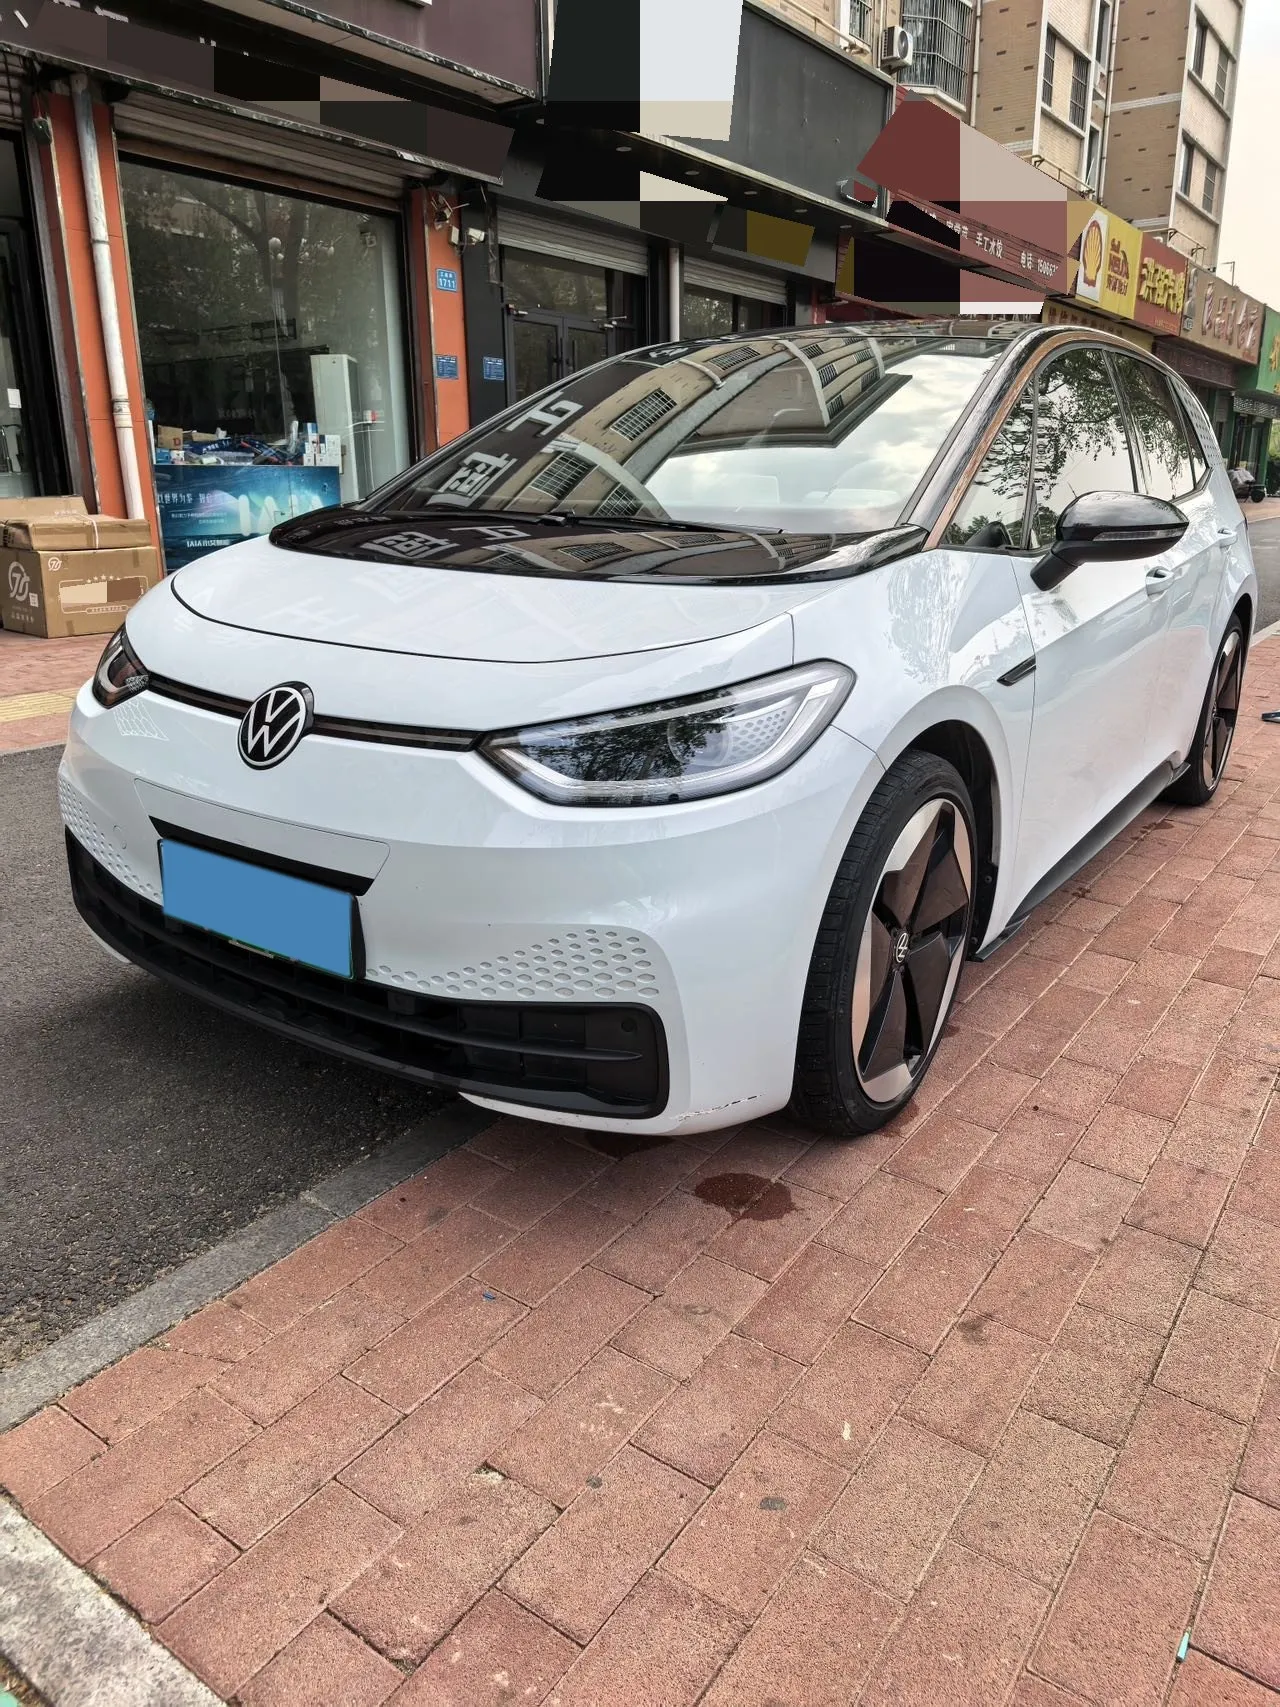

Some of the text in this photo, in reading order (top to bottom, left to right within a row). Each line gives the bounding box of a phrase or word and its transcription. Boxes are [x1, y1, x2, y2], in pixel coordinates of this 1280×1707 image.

[975, 232, 1004, 259] 手工水饺
[439, 278, 455, 288] 1711
